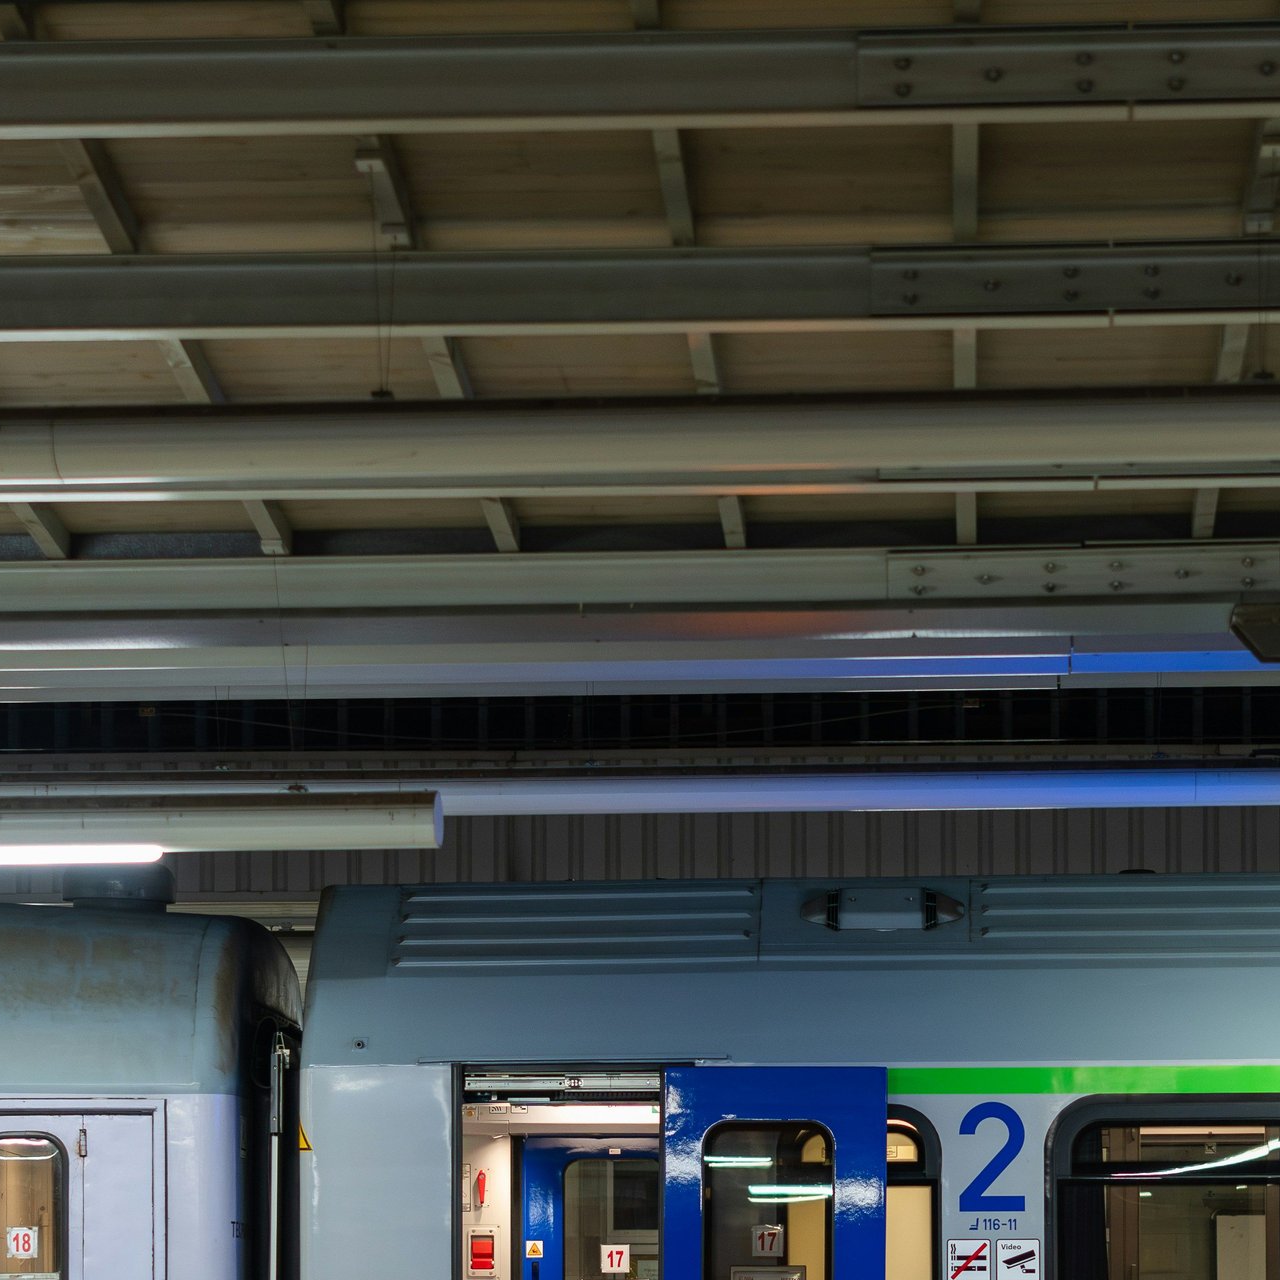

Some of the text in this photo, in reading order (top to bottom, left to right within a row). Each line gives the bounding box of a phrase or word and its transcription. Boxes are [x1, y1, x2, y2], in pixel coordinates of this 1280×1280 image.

[959, 1101, 1026, 1212] 2
[983, 1218, 1017, 1231] 116-11
[12, 1233, 31, 1252] 18
[758, 1231, 777, 1251] 17
[607, 1250, 624, 1268] 17
